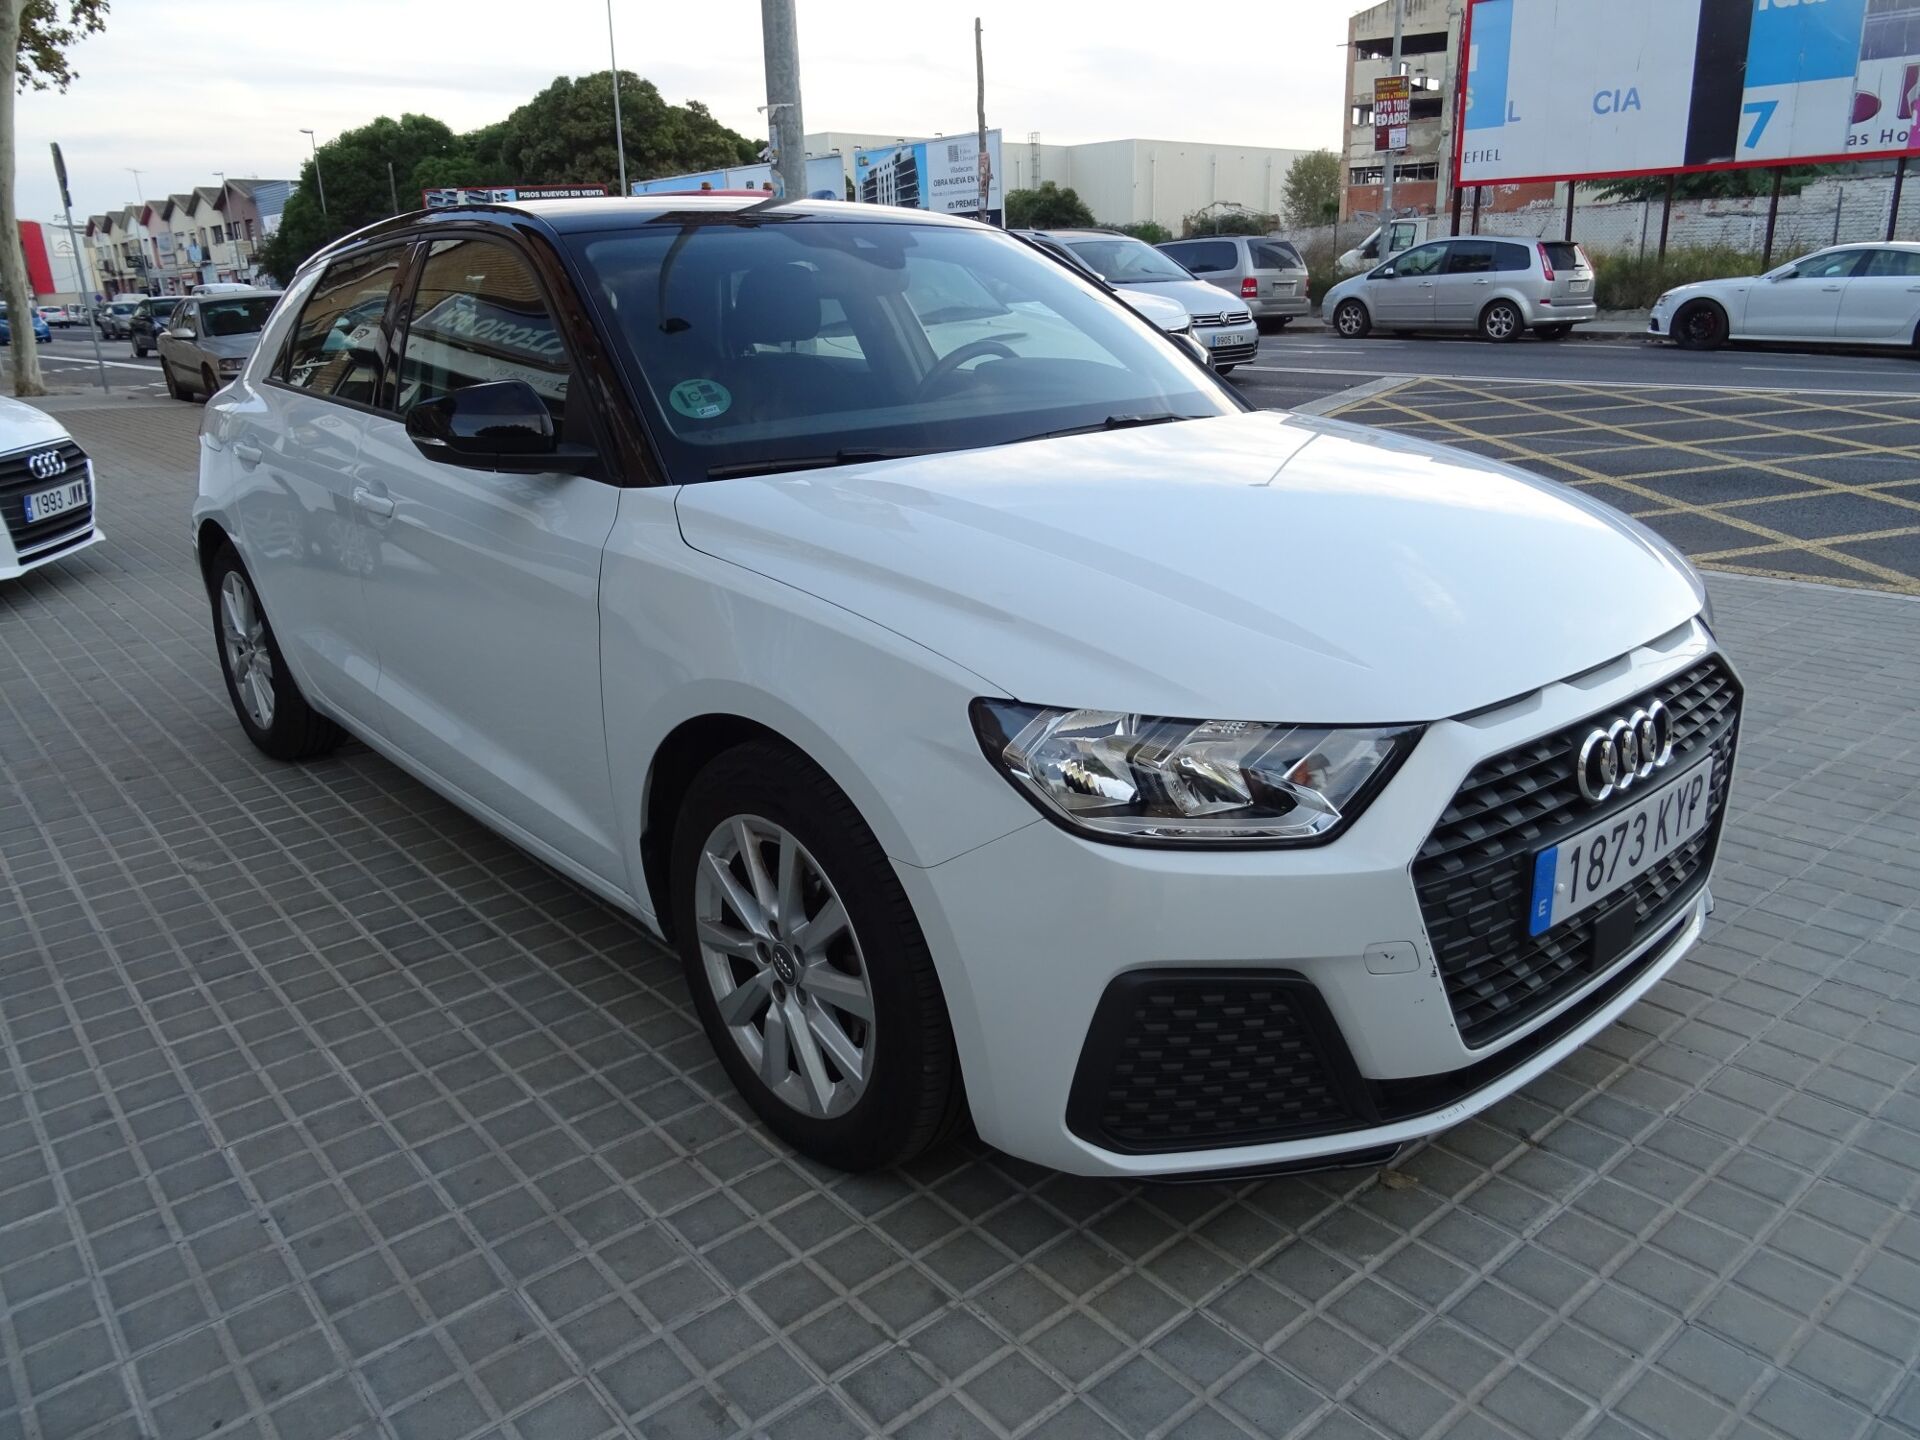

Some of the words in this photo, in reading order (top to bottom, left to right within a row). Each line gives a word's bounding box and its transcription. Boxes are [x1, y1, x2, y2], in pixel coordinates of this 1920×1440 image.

[1376, 101, 1392, 113] APTO
[1593, 87, 1641, 115] CIA
[1376, 112, 1409, 126] EDADES
[1743, 100, 1779, 149] 7
[1464, 149, 1502, 164] EFIEL
[933, 177, 948, 187] OBRA
[949, 174, 967, 185] NUEVA
[967, 175, 976, 183] EN
[541, 190, 569, 198] NUEVOS
[36, 490, 64, 515] 1993
[1570, 811, 1647, 903] 1873
[1654, 774, 1703, 852] KYP
